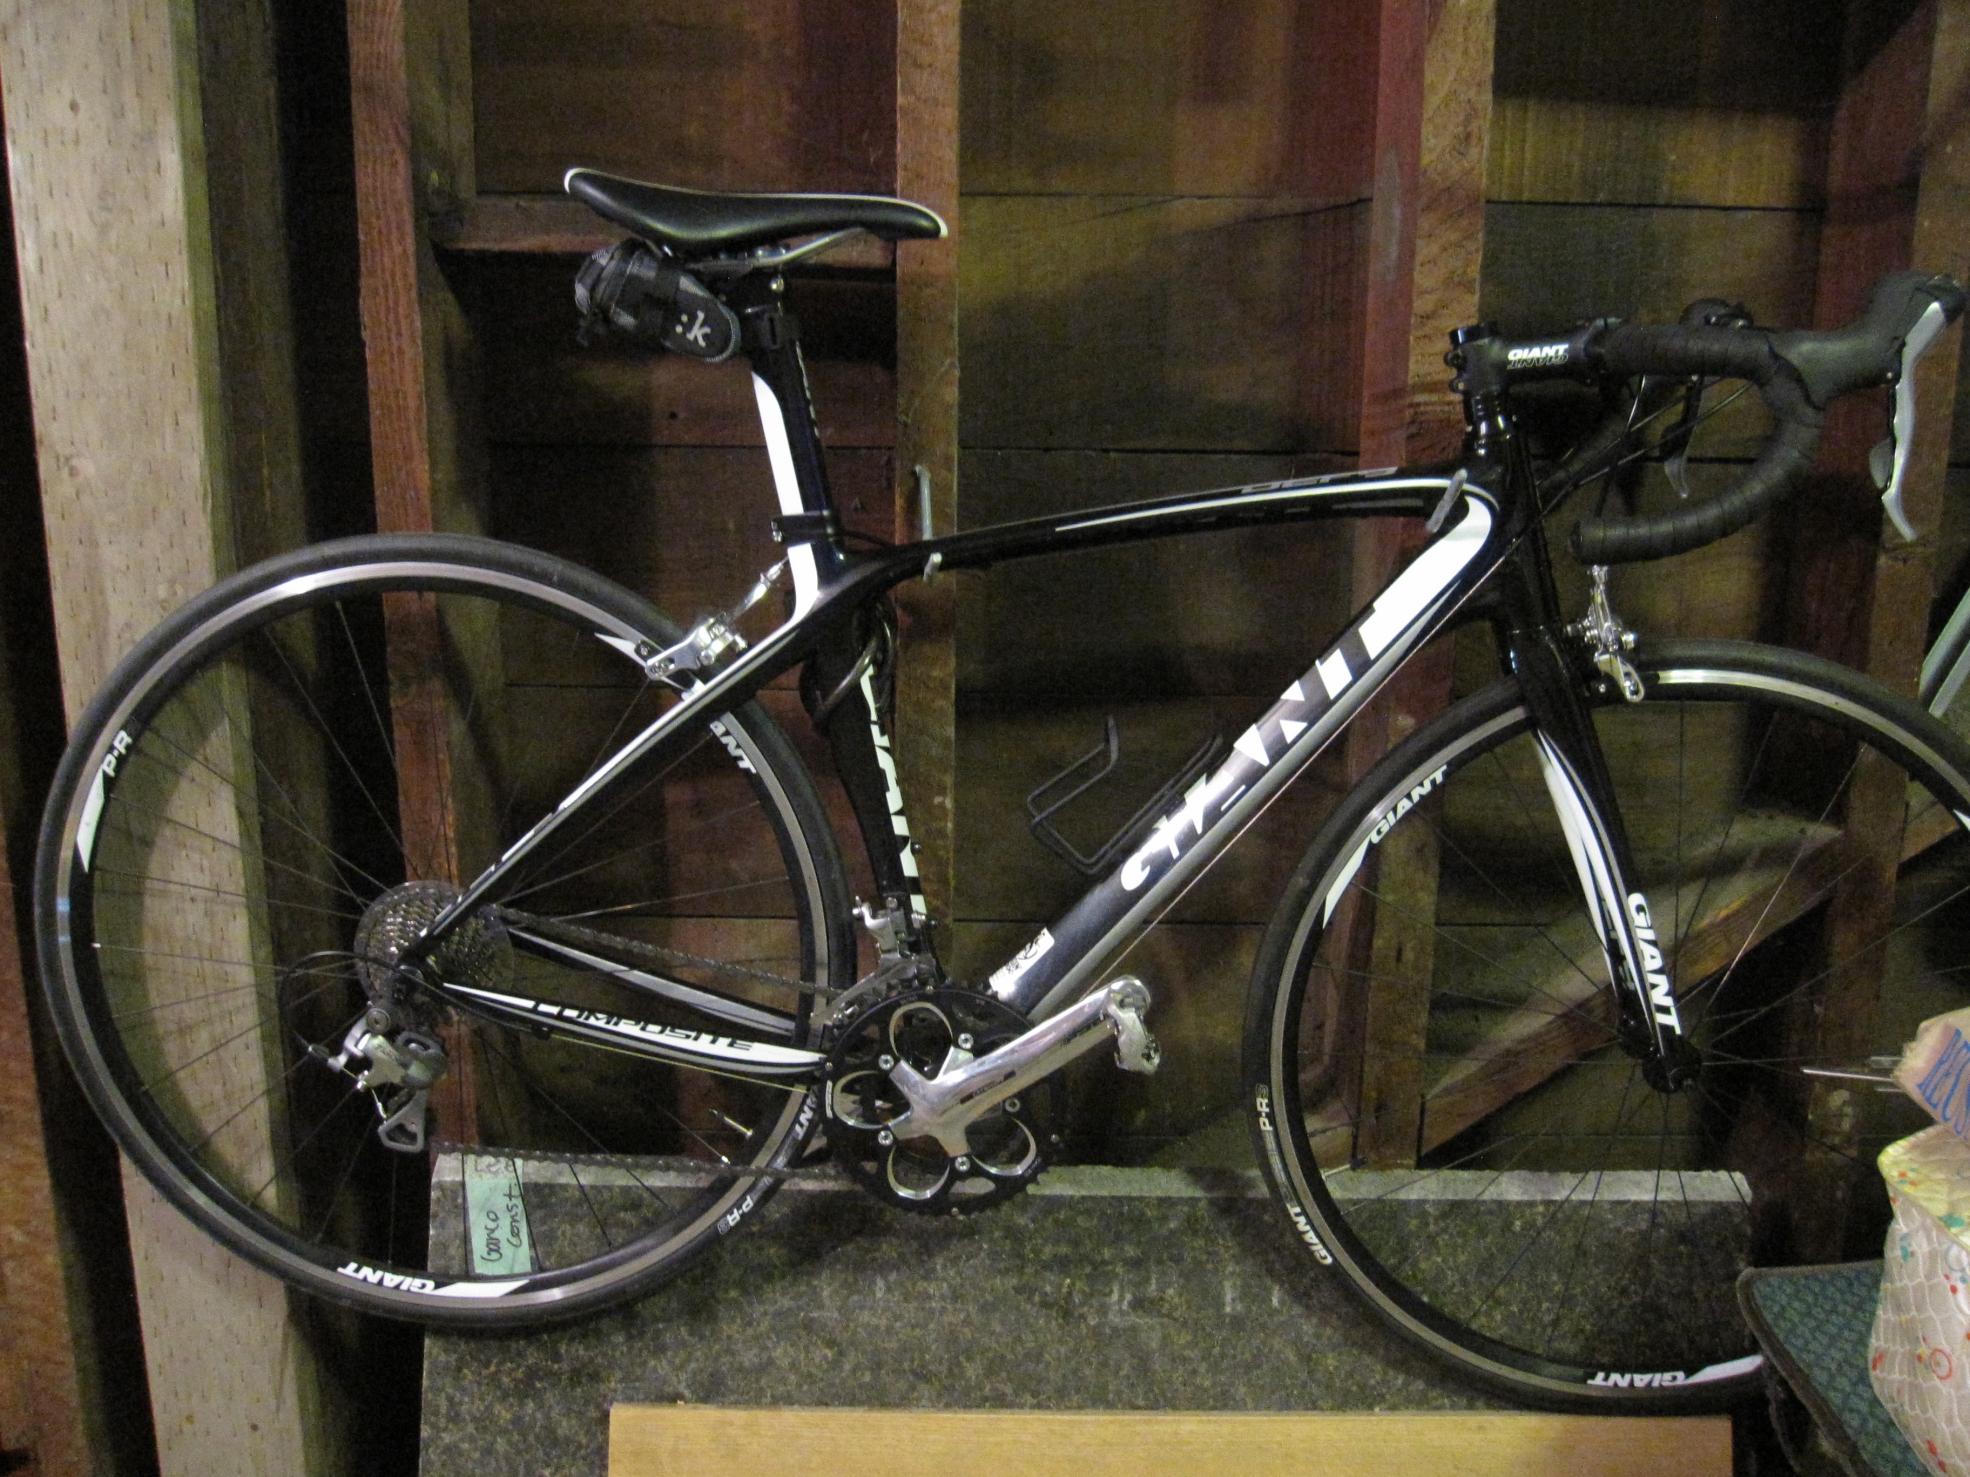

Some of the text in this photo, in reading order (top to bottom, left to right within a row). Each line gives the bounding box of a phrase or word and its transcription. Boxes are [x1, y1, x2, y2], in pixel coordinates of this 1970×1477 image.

[1507, 343, 1569, 361] GIANT
[1369, 764, 1448, 844] GIANT
[1627, 892, 1682, 1035] GIANT
[531, 1001, 753, 1052] COMPOSITE
[1286, 1203, 1333, 1266] GIANT
[336, 1261, 436, 1293] GIANT
[1586, 1370, 1687, 1388] GIANT
